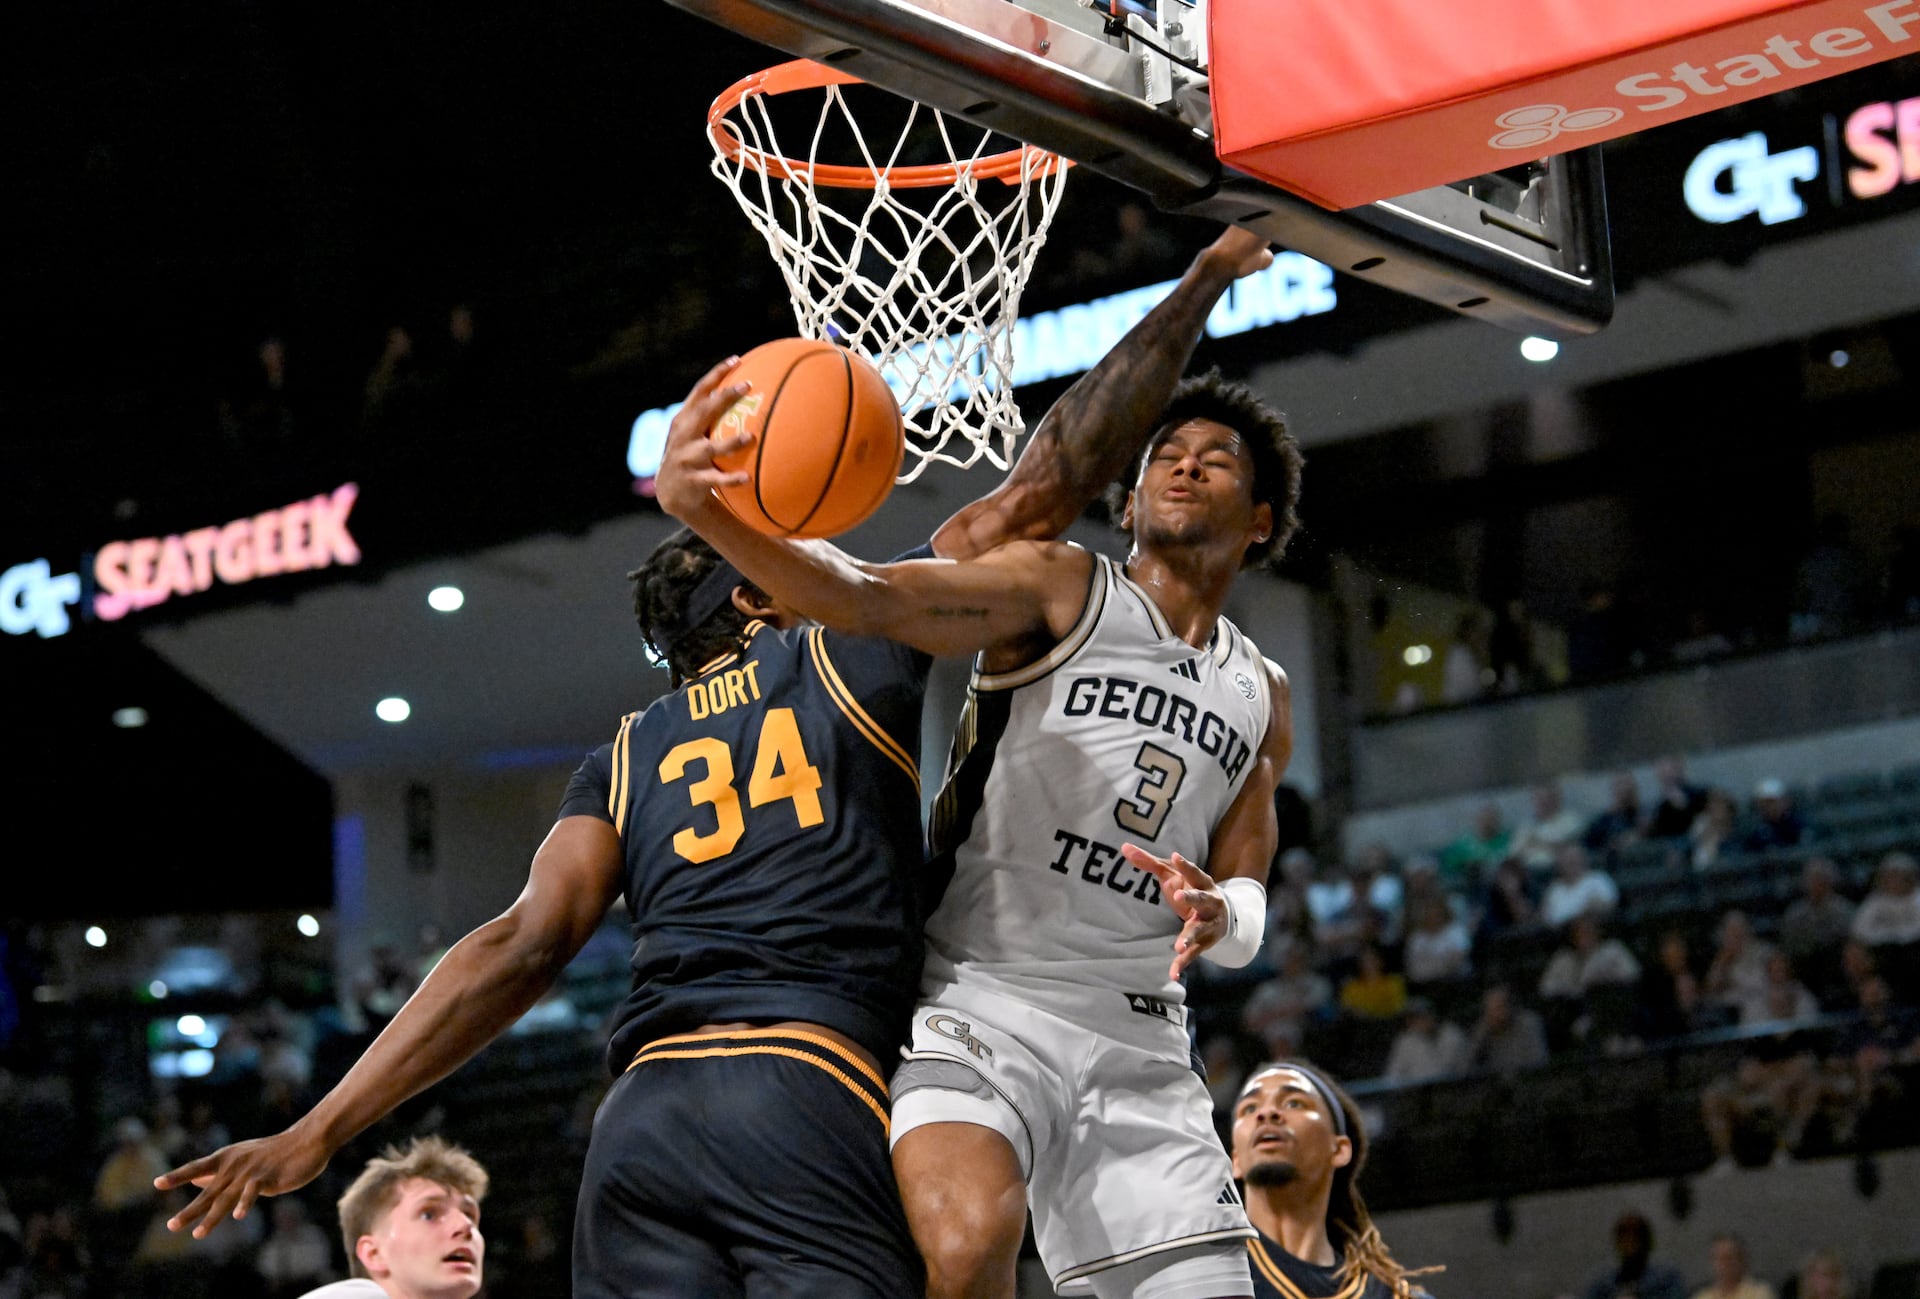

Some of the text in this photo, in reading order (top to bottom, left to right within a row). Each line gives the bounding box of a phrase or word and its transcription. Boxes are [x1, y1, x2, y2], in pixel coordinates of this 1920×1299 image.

[1683, 130, 1820, 226] GT
[94, 481, 361, 621] SEATGEEK
[687, 660, 761, 721] DORT
[1063, 677, 1251, 790] GEORGIA
[658, 707, 825, 865] 34
[1113, 740, 1187, 842] 3
